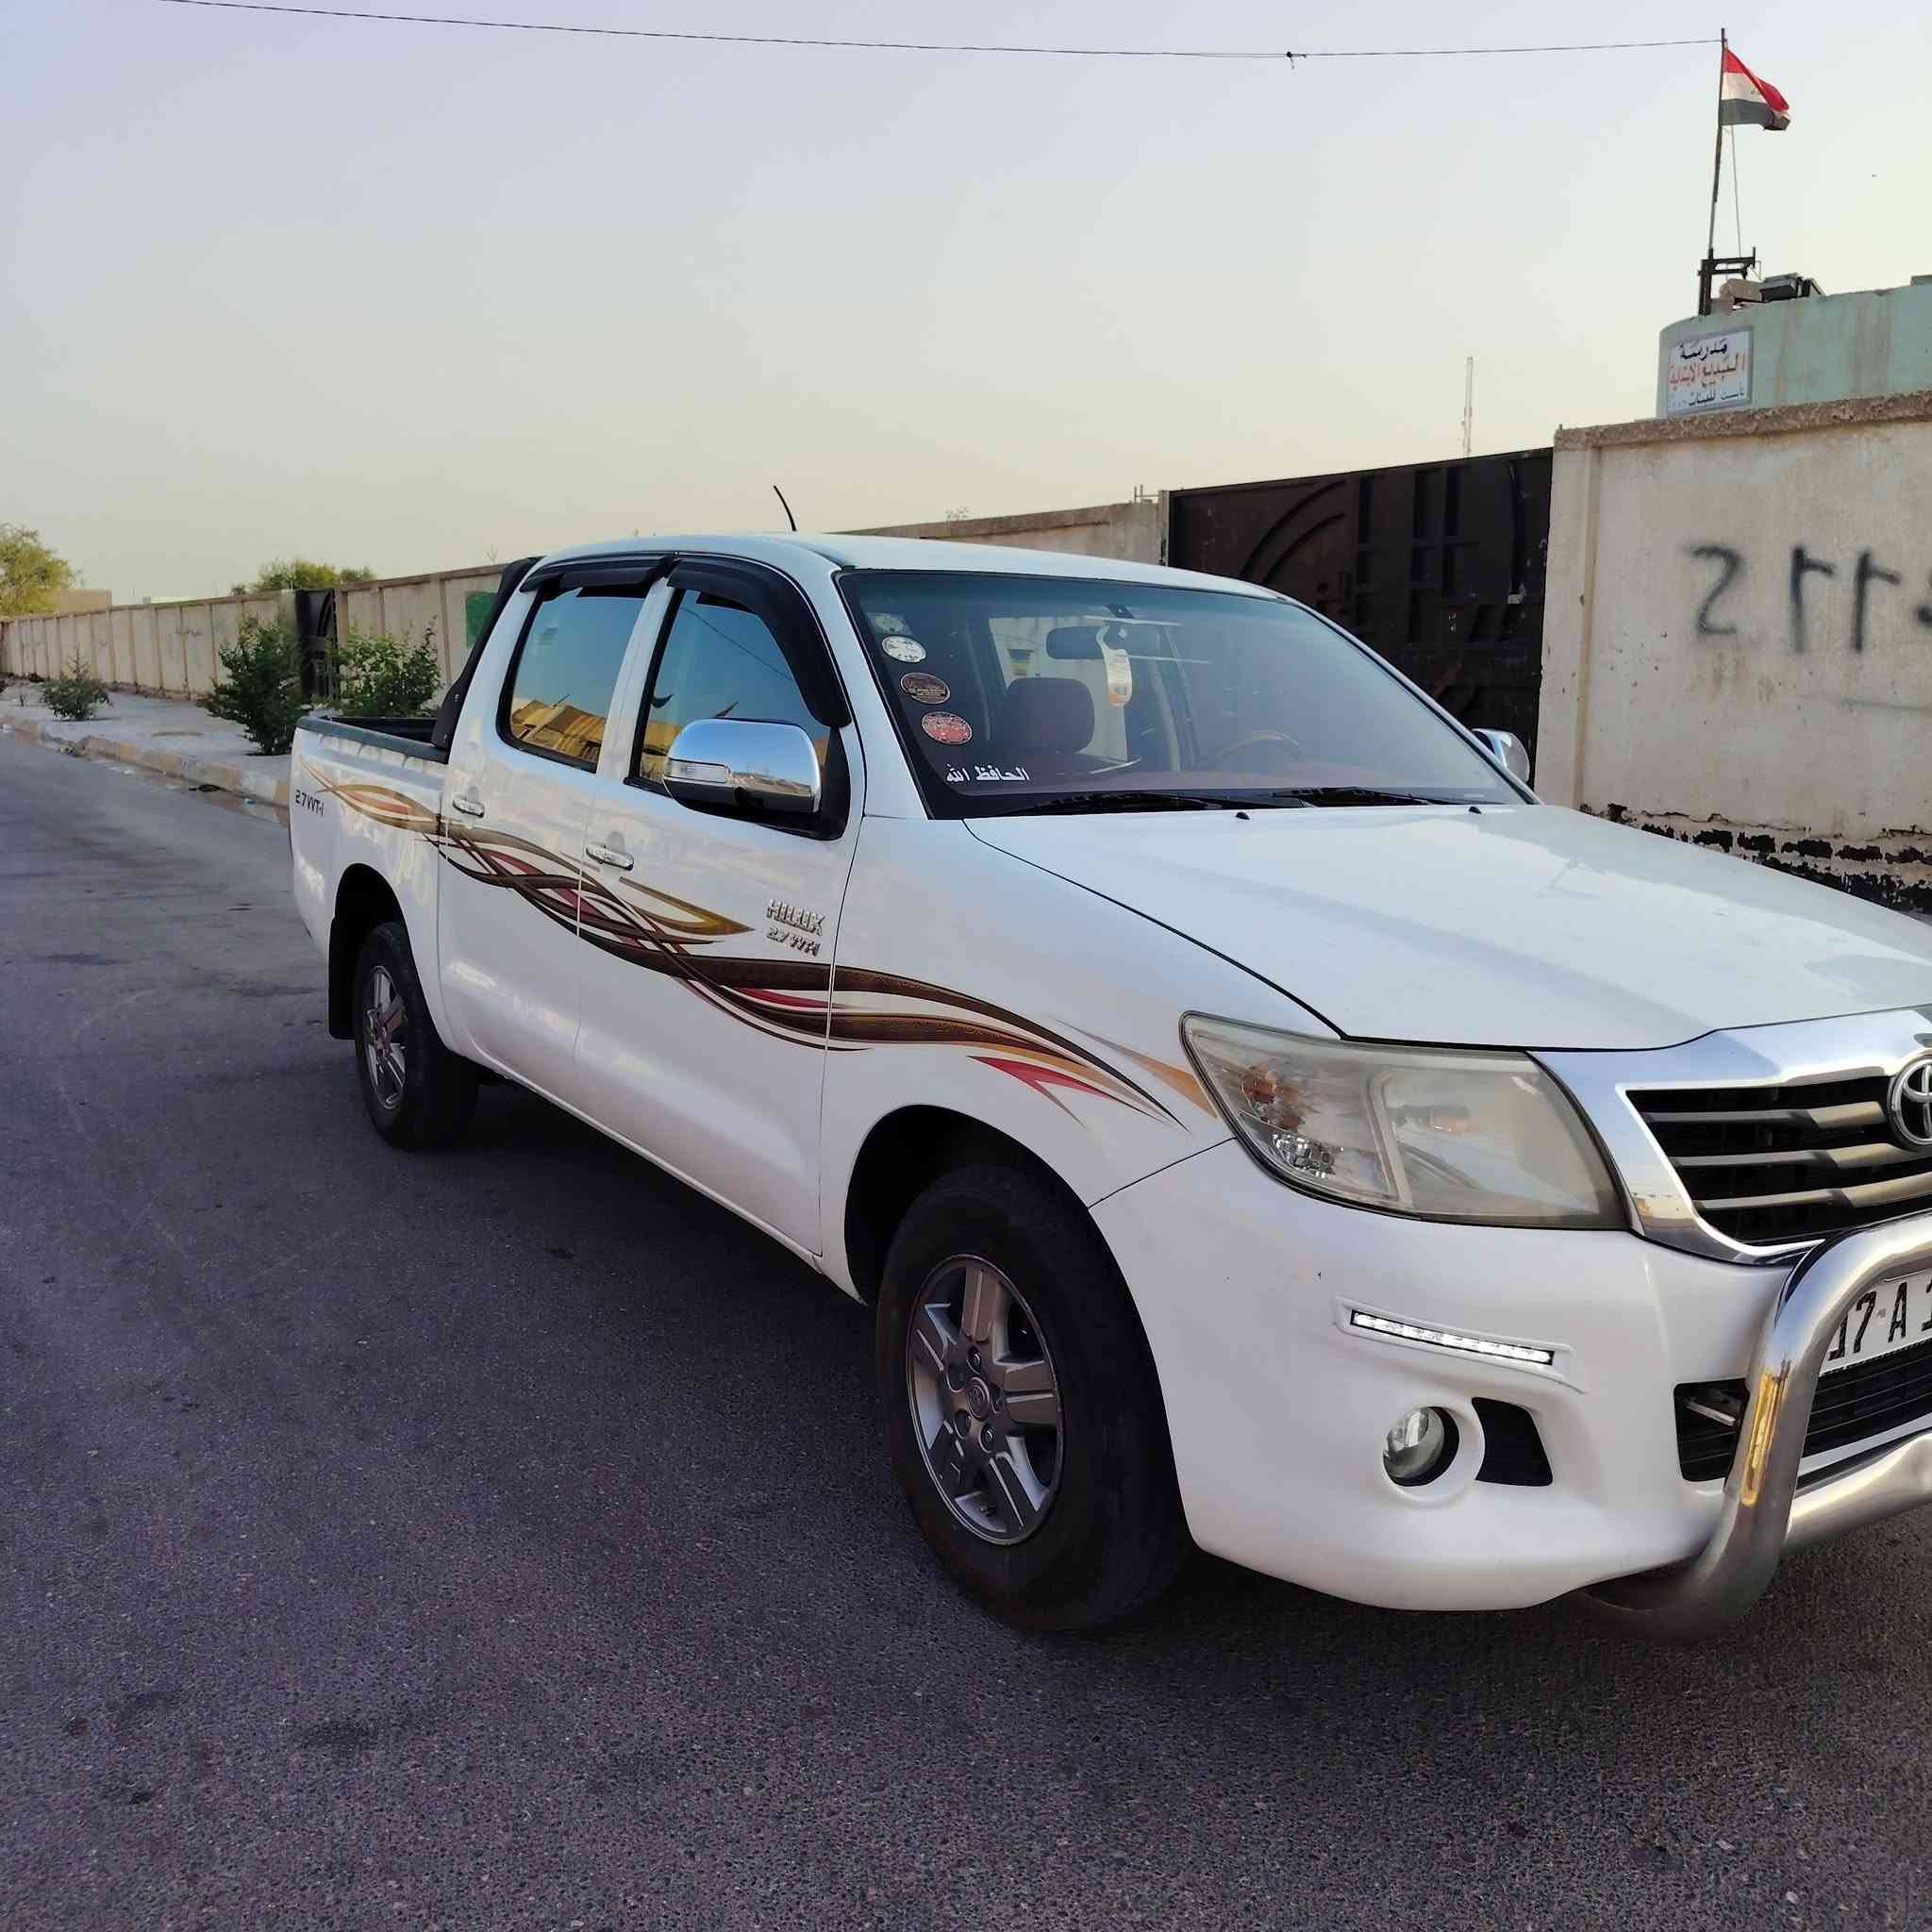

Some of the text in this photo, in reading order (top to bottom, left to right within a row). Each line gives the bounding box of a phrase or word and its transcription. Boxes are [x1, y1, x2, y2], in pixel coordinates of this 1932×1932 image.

[946, 763, 1029, 782] الحافظ الله
[1888, 1281, 1907, 1343] A
